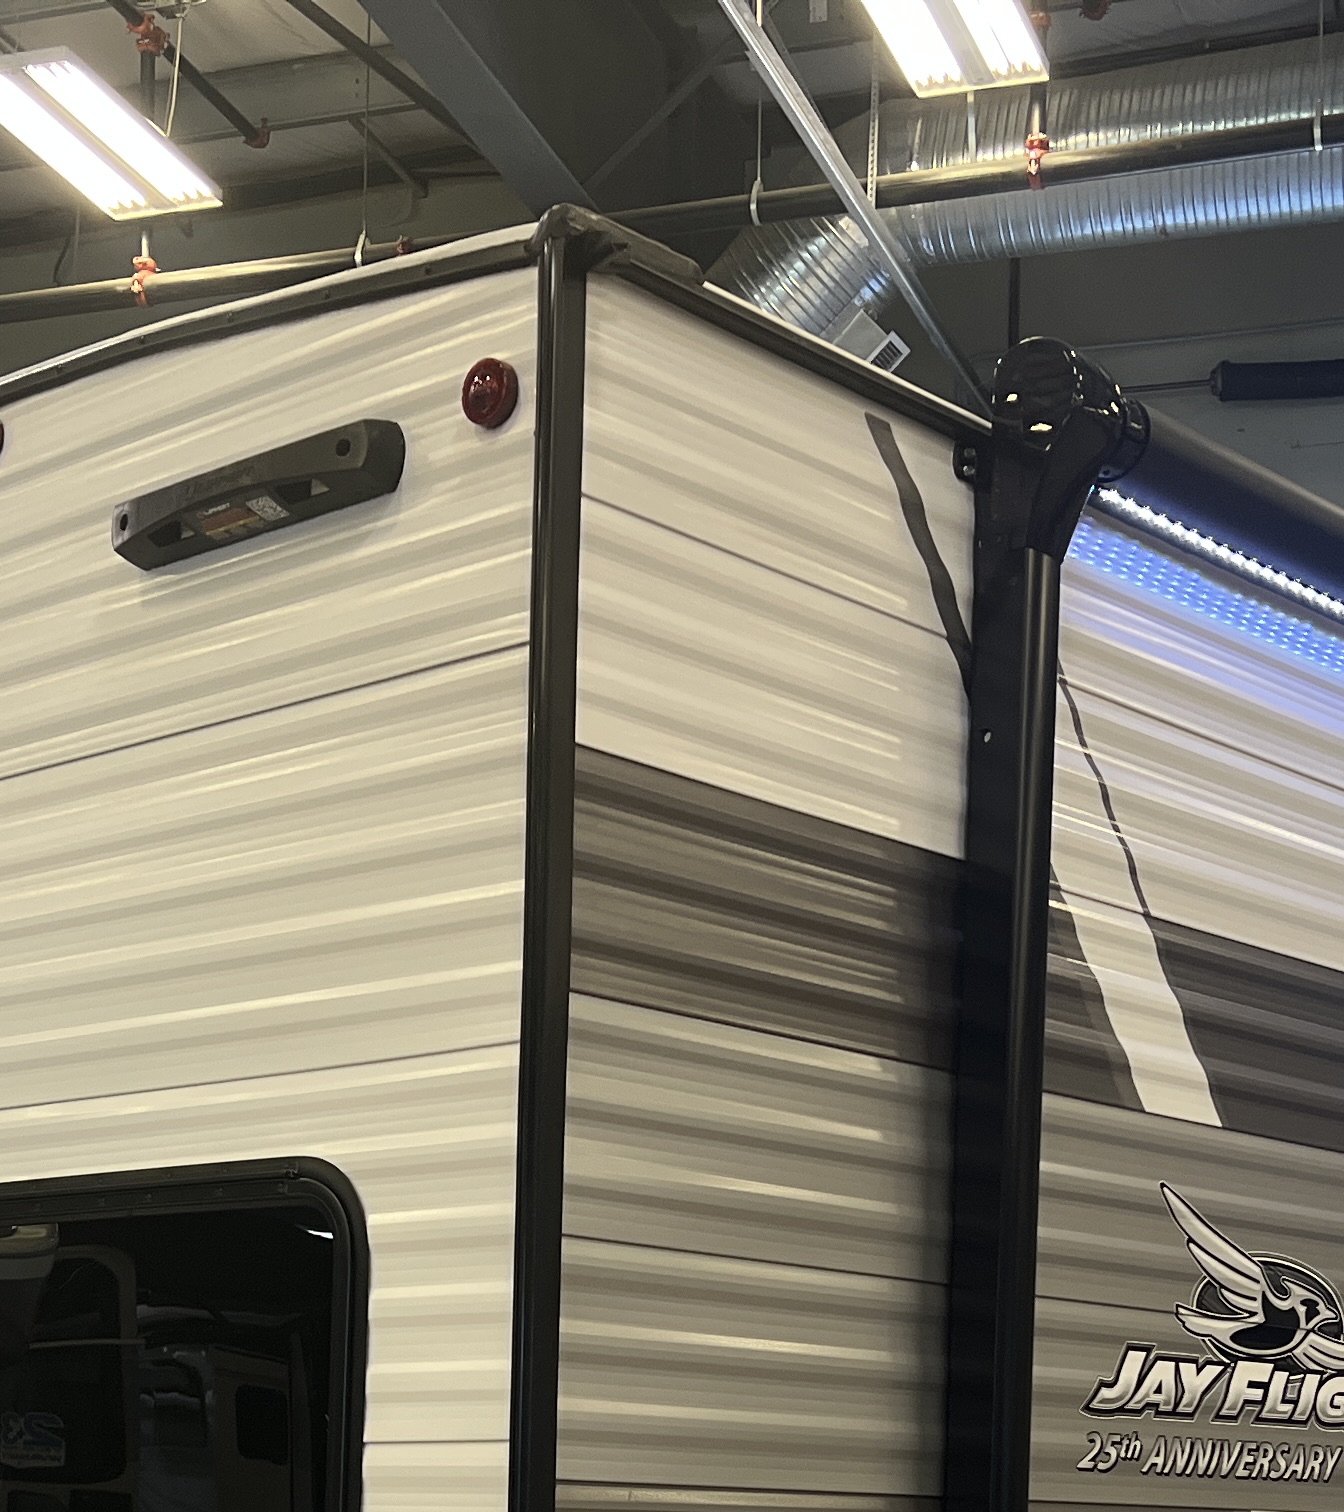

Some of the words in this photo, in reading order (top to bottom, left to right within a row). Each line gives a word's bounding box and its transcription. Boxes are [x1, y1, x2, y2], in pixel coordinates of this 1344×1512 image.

[1080, 1341, 1231, 1422] JAY
[1076, 1431, 1144, 1474] 25th
[1141, 1435, 1344, 1483] ANNIVERSARY
